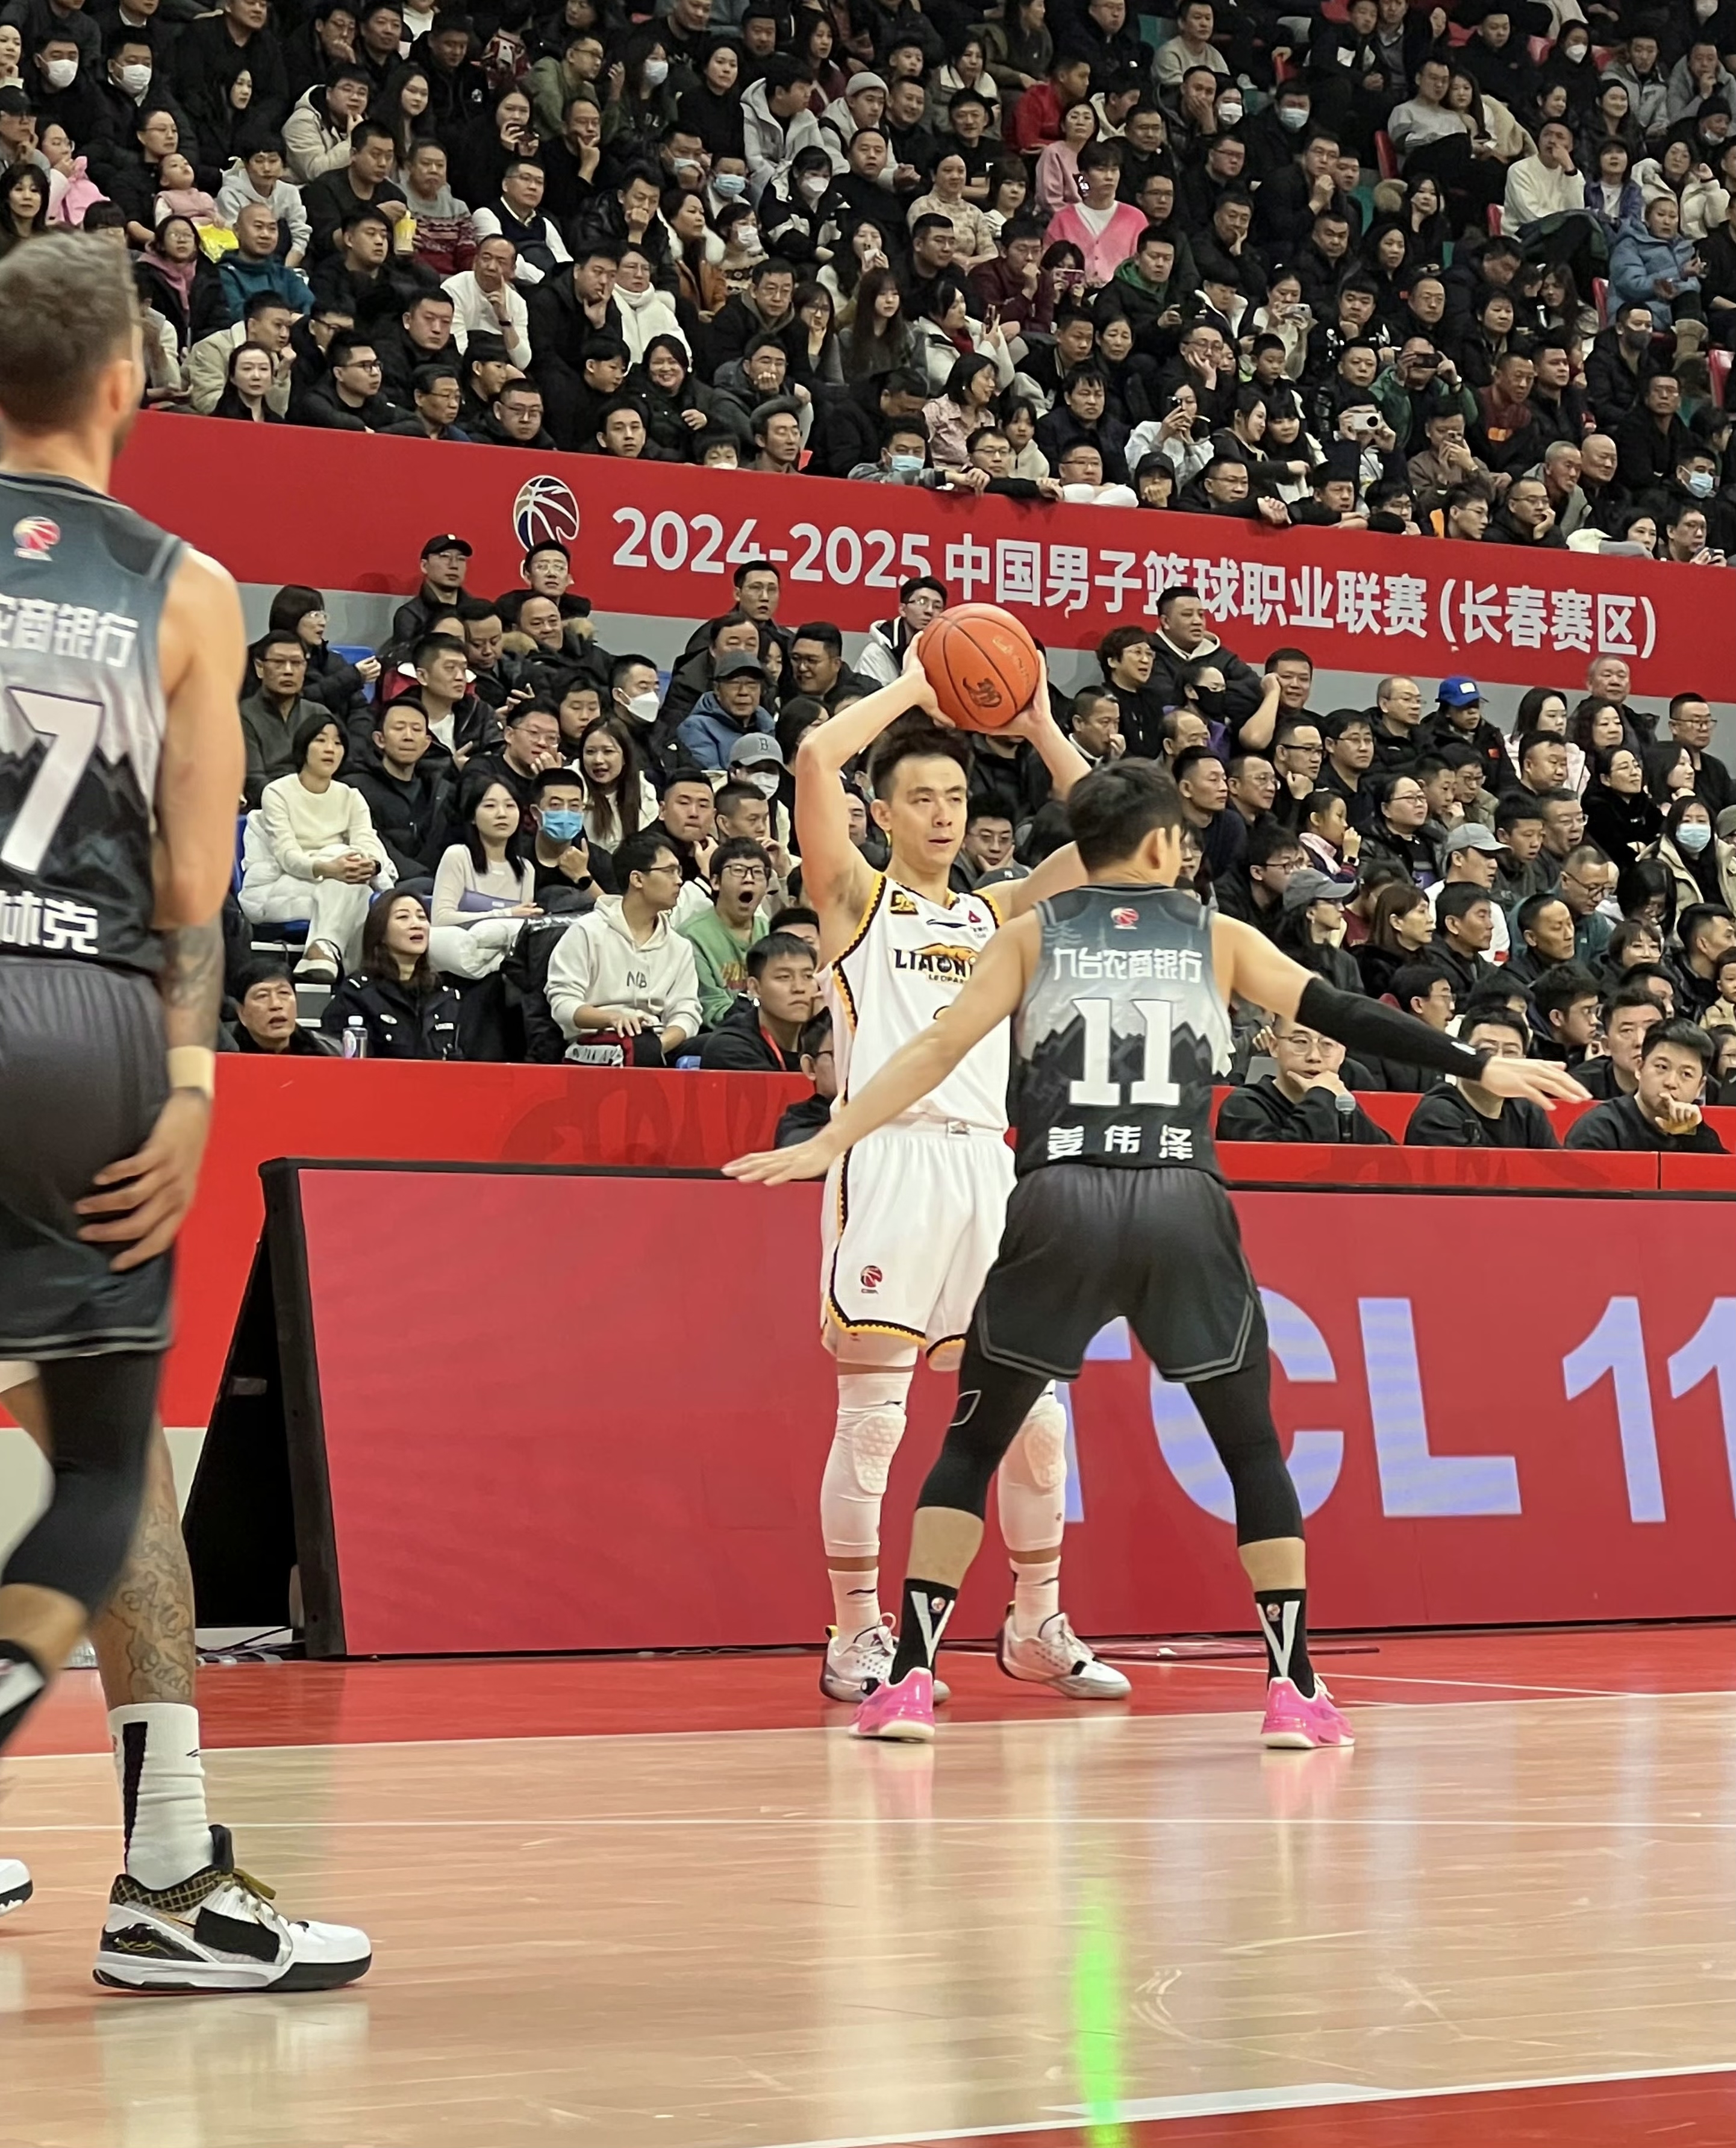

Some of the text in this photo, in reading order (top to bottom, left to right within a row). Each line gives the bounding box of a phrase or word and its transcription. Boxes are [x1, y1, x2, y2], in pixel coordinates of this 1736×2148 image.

[612, 507, 932, 588] 2024-2025
[1, 685, 104, 875] 7
[1070, 998, 1180, 1107] 11
